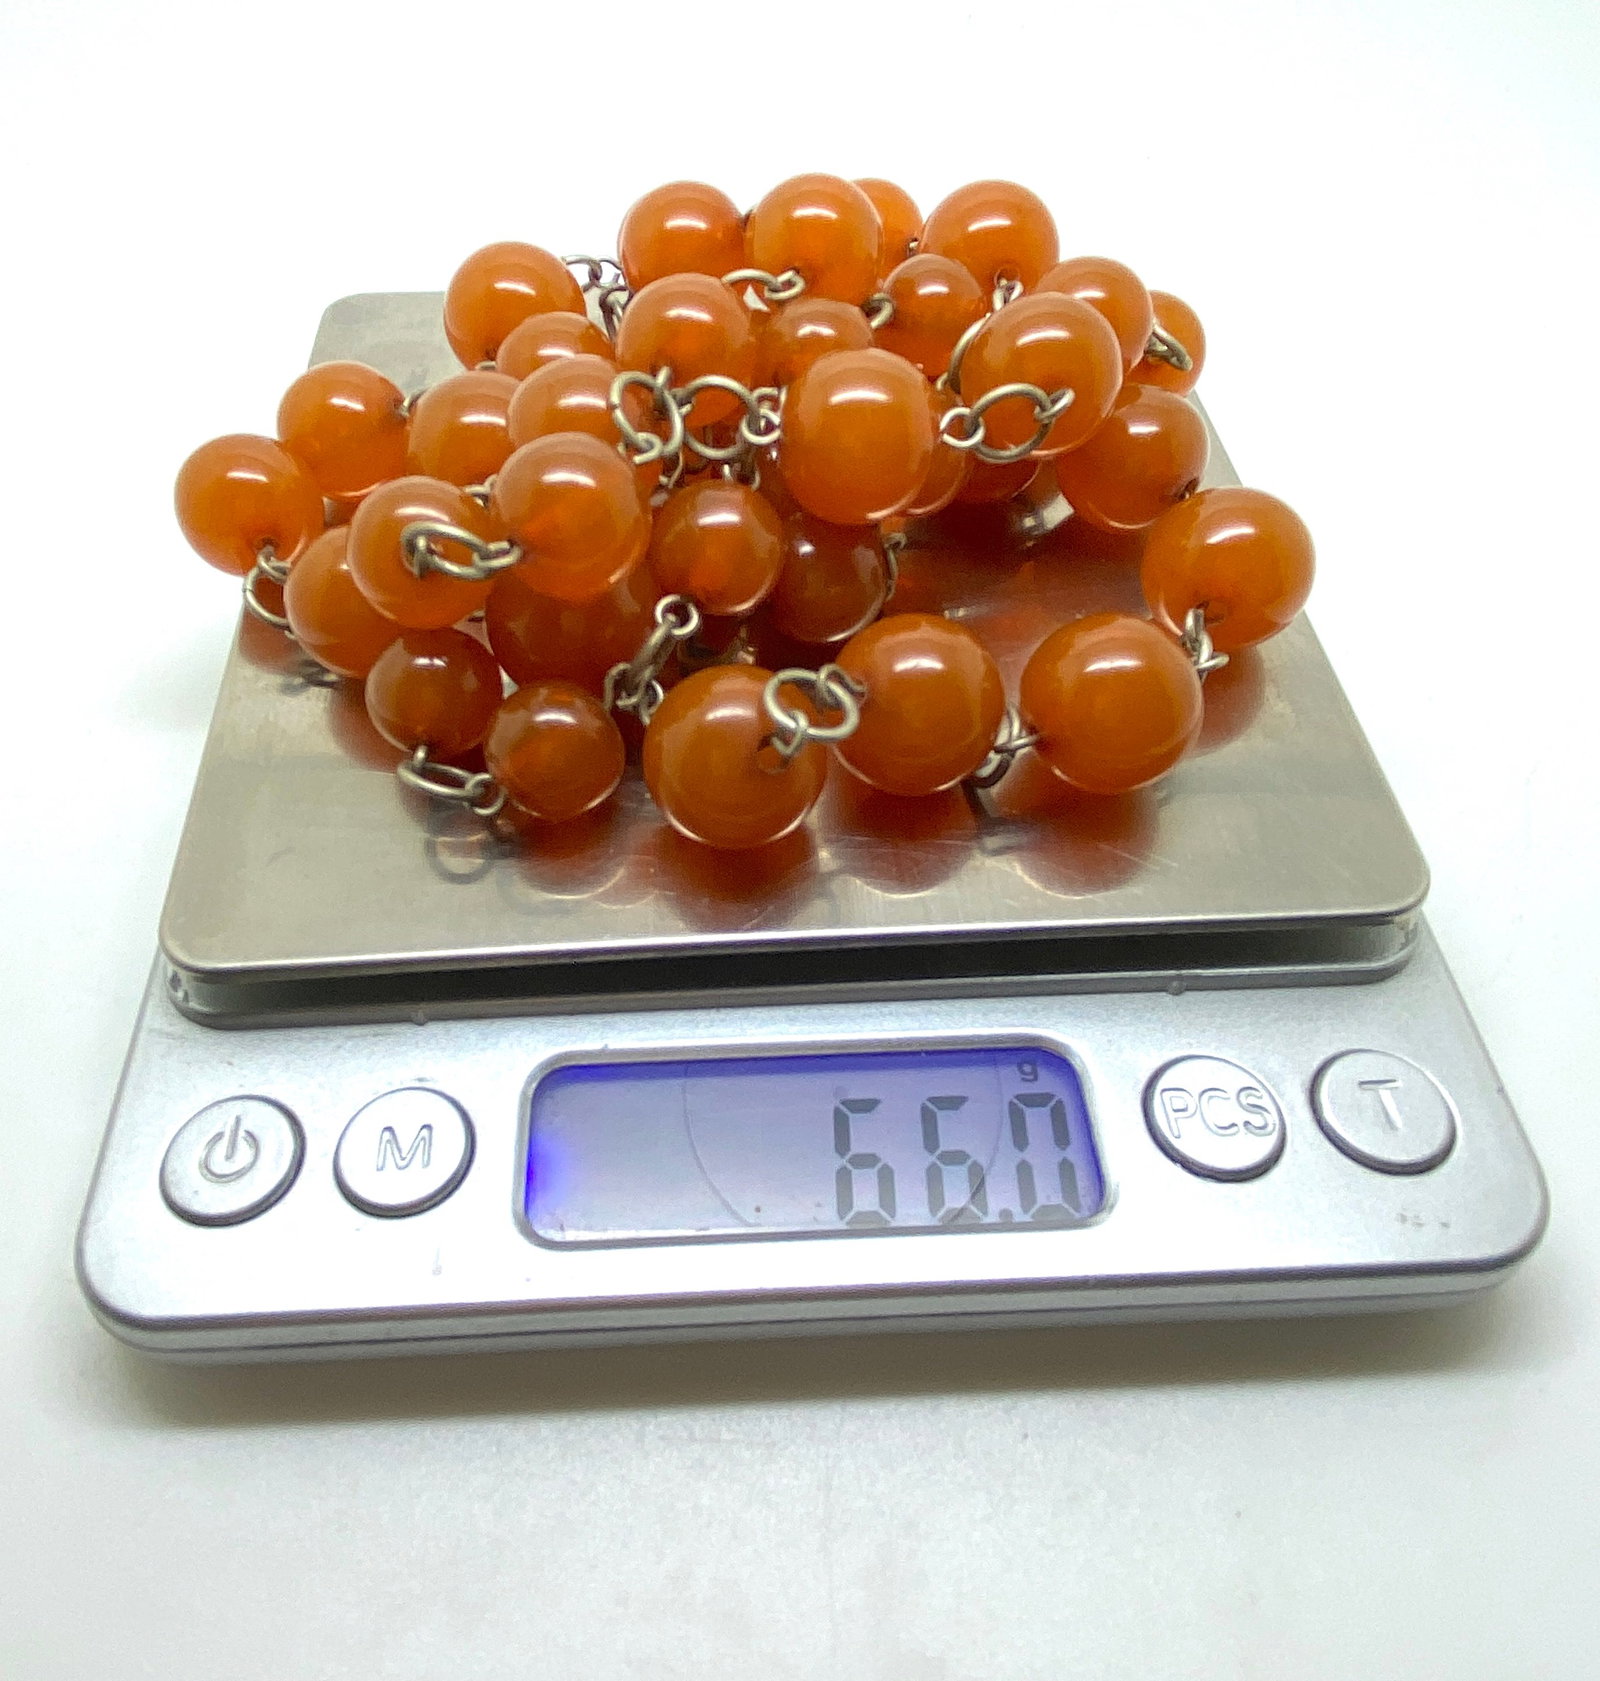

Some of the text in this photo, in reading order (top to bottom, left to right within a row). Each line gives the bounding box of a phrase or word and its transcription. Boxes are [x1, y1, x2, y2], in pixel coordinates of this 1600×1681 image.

[1016, 1060, 1039, 1083] g
[1160, 1086, 1277, 1139] PCS
[1357, 1078, 1402, 1131] T
[375, 1123, 434, 1172] M
[832, 1092, 1081, 1227] 66.0
